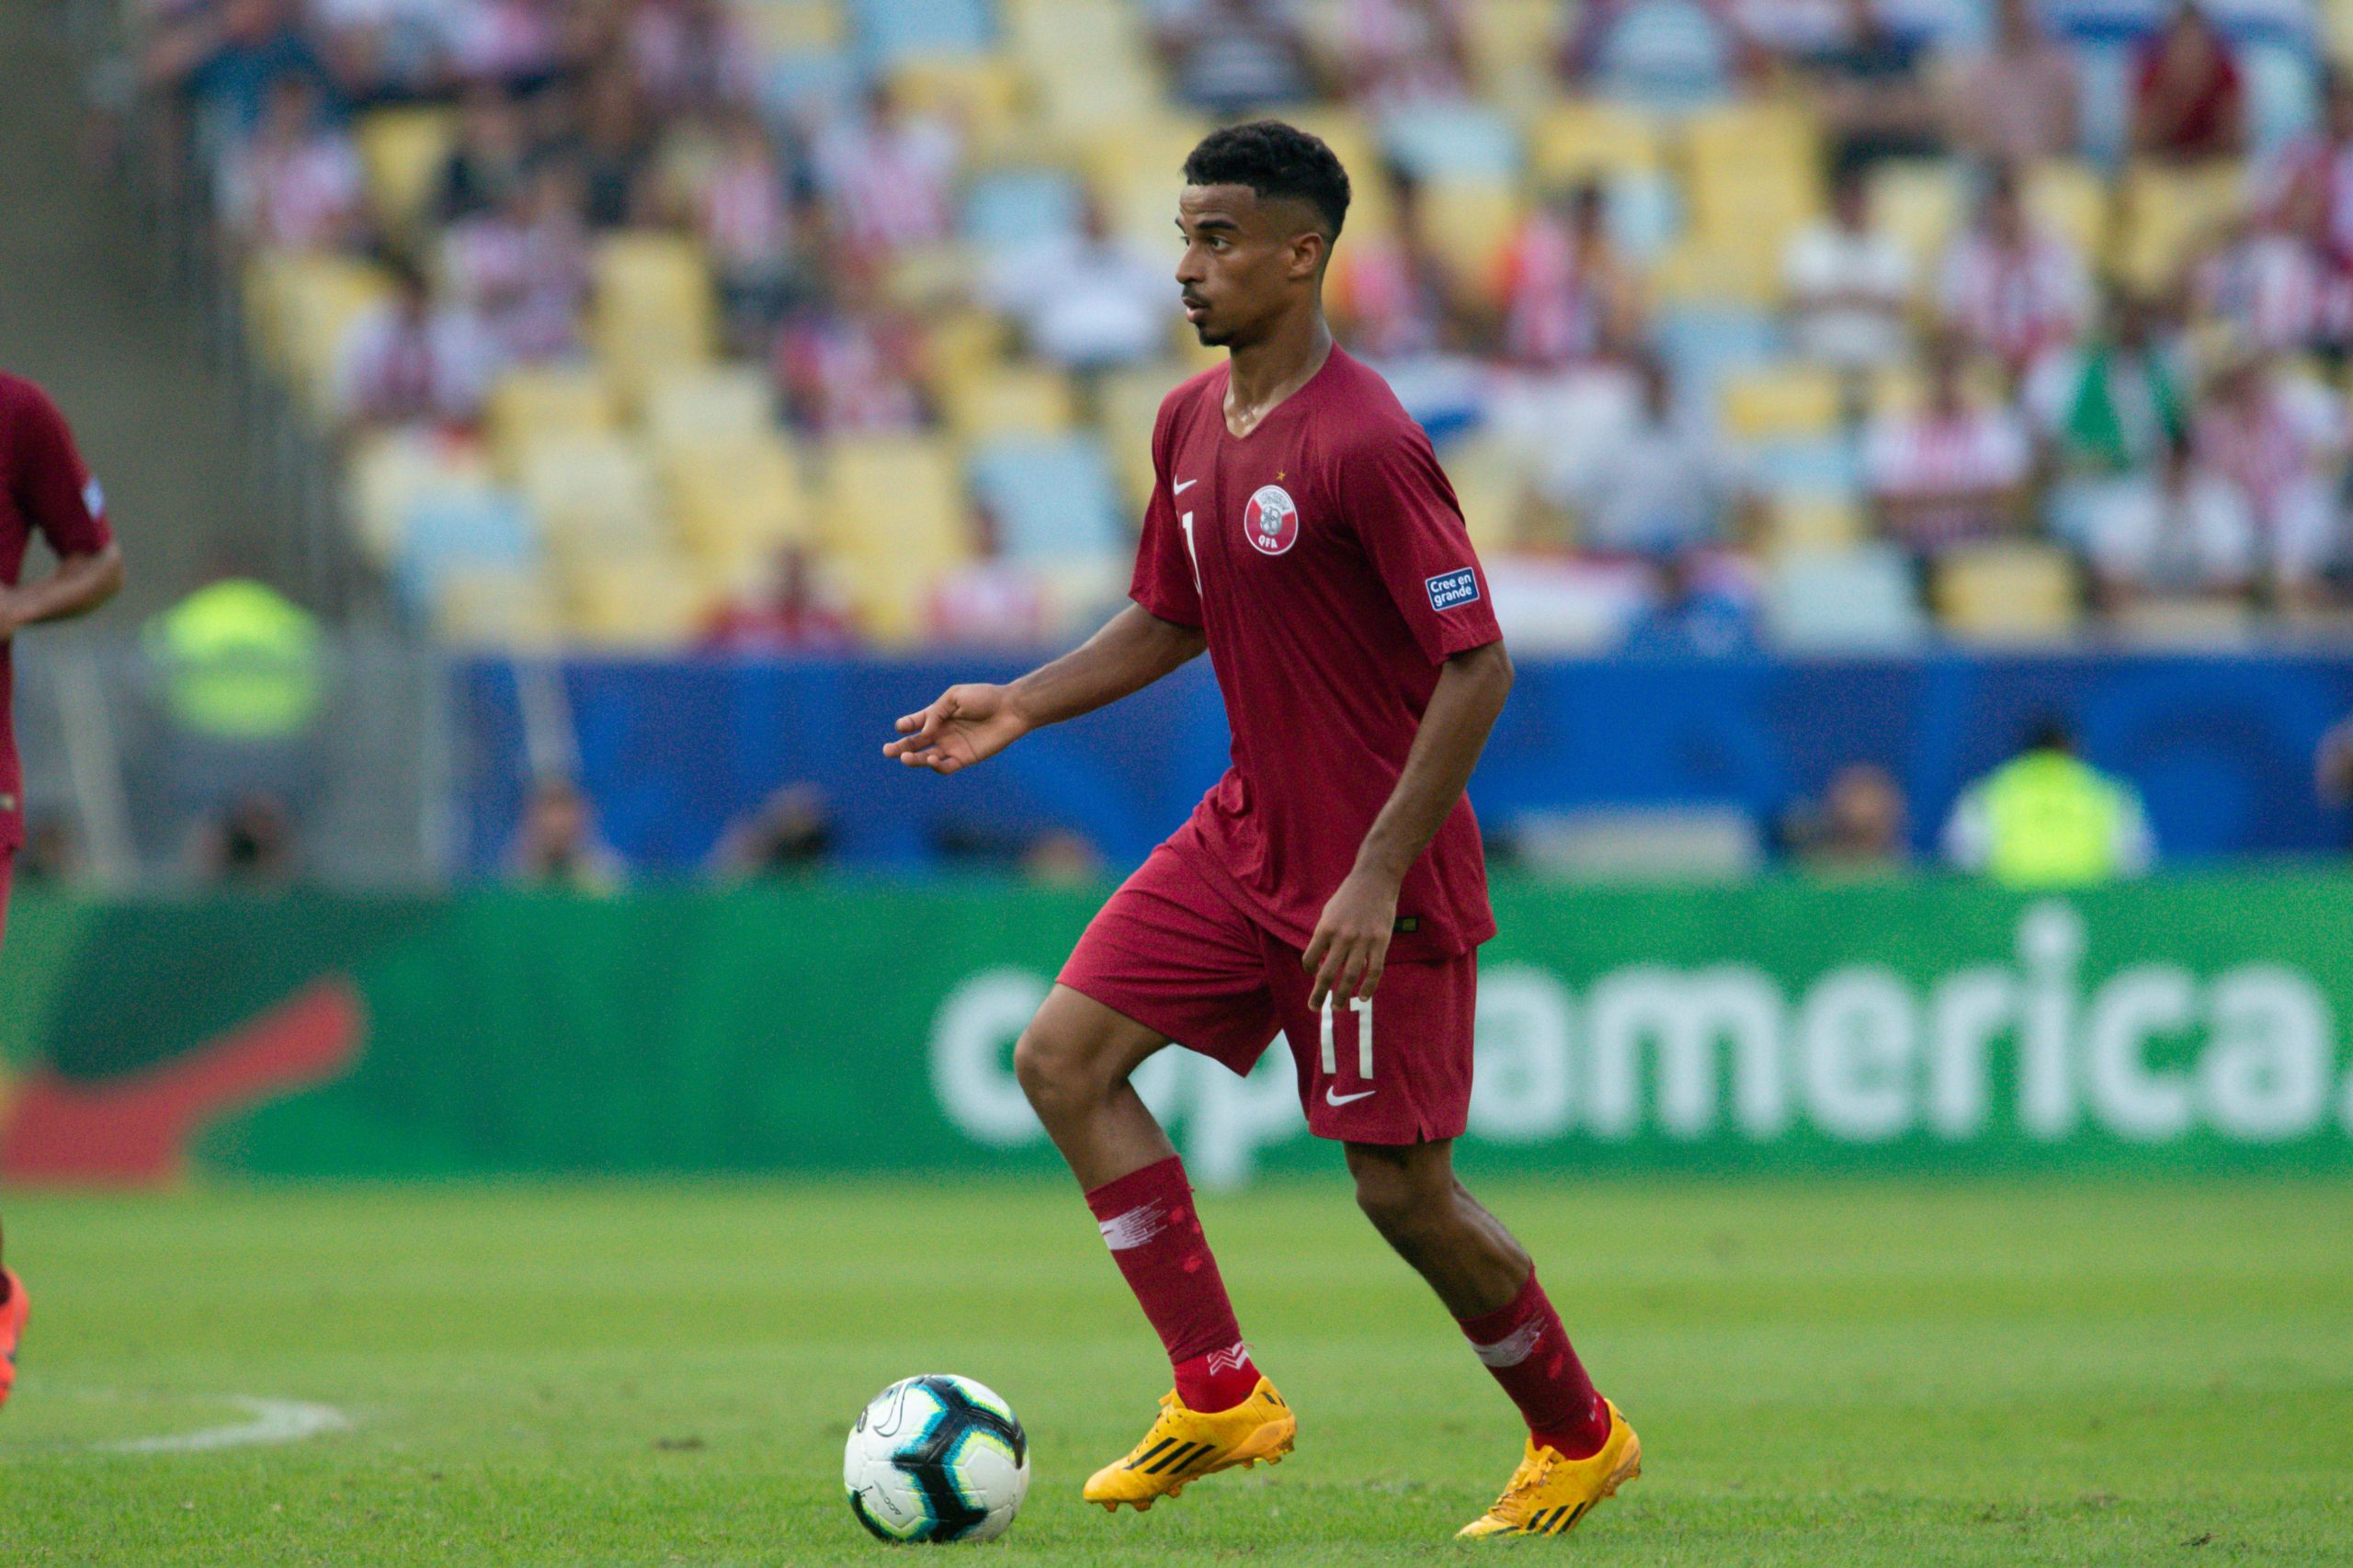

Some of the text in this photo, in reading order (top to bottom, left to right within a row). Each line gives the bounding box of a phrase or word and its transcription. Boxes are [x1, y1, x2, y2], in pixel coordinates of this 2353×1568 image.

[1258, 535, 1278, 549] QFA
[1430, 574, 1472, 593] Cree en
[1434, 585, 1472, 607] grande
[1321, 989, 1373, 1079] 11
